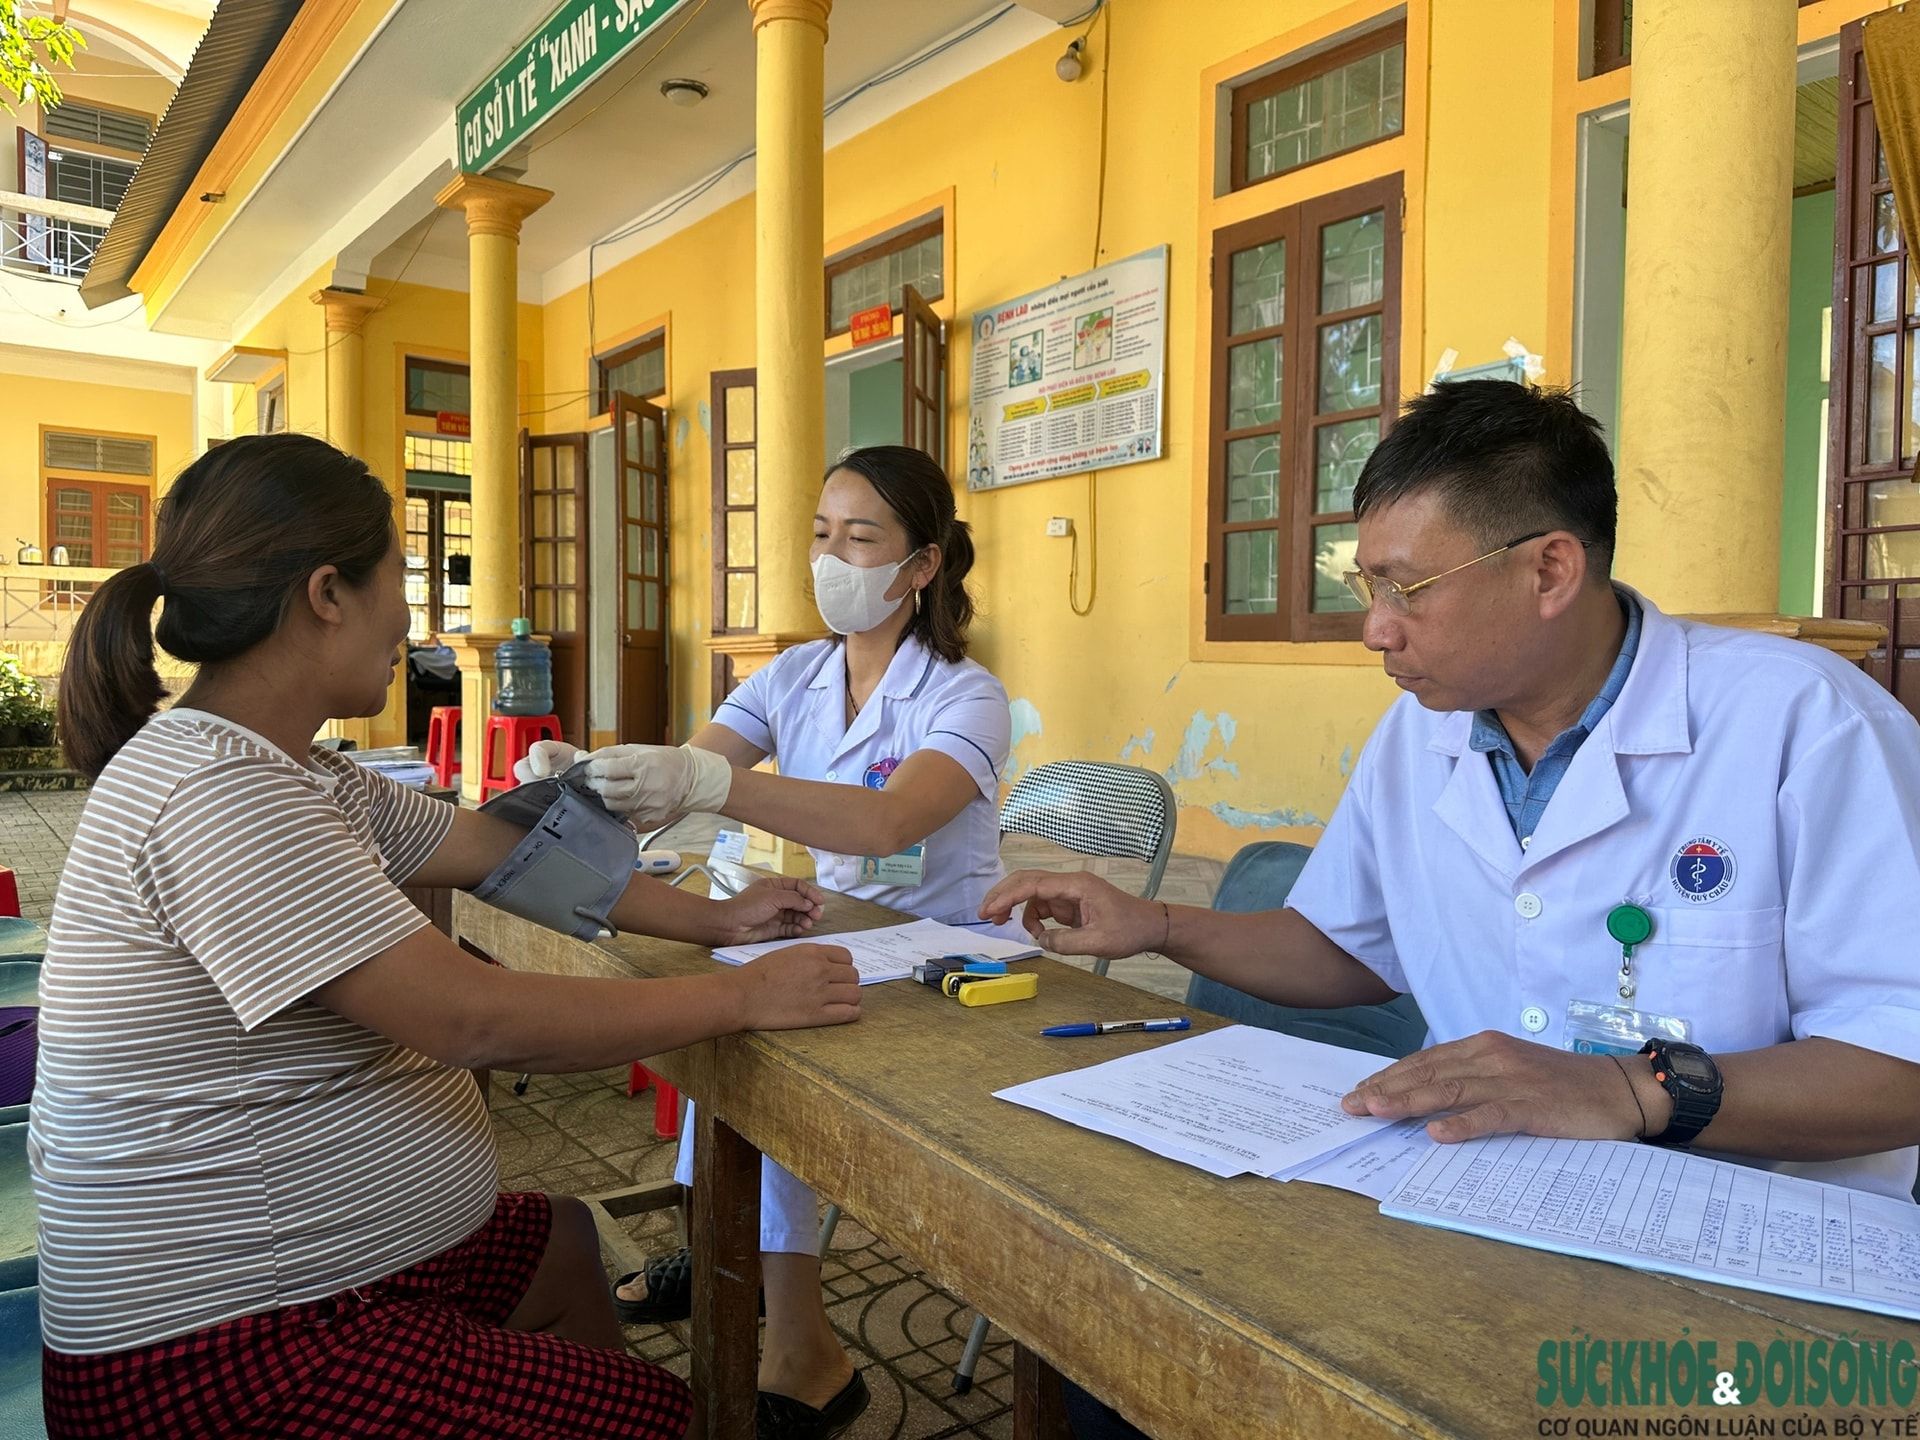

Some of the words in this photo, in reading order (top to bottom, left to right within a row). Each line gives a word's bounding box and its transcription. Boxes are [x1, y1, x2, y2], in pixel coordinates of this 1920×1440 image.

[464, 107, 482, 165] CƠ
[484, 78, 504, 148] SỞ
[505, 79, 515, 129] Y
[518, 42, 538, 117] TẾ
[998, 309, 1014, 324] BỆNH
[1016, 303, 1028, 317] LAO
[556, 808, 567, 822] MIN
[533, 841, 544, 850] OK
[1678, 838, 1698, 855] TRUNG
[1697, 837, 1712, 846] TÂM
[1718, 844, 1729, 856] TẾ
[496, 869, 516, 888] INDEX
[1671, 879, 1690, 899] HUYỆN
[1709, 881, 1729, 899] CHÂU
